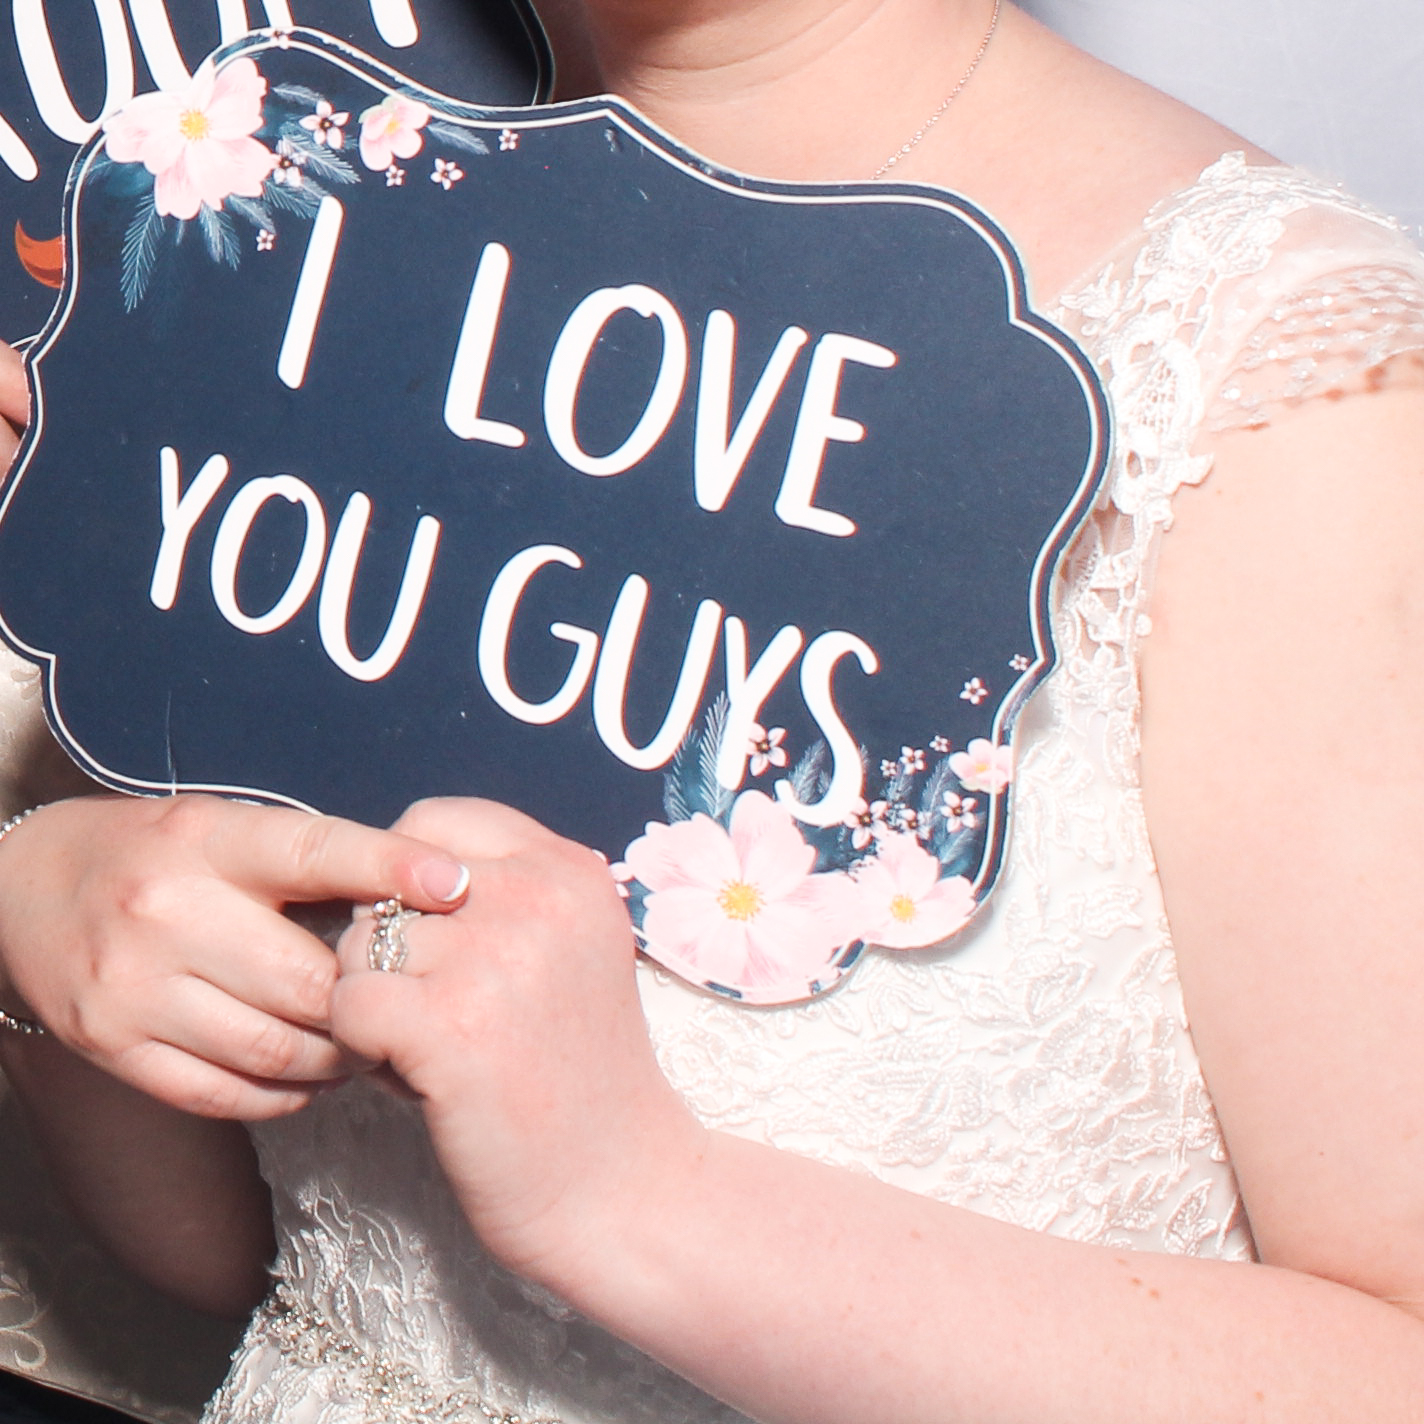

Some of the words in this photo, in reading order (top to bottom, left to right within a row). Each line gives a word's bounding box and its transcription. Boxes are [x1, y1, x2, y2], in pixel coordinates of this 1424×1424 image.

[276, 195, 344, 390] I
[443, 241, 897, 538] LOVE
[150, 445, 441, 682] YOU
[477, 543, 880, 827] GUYS
